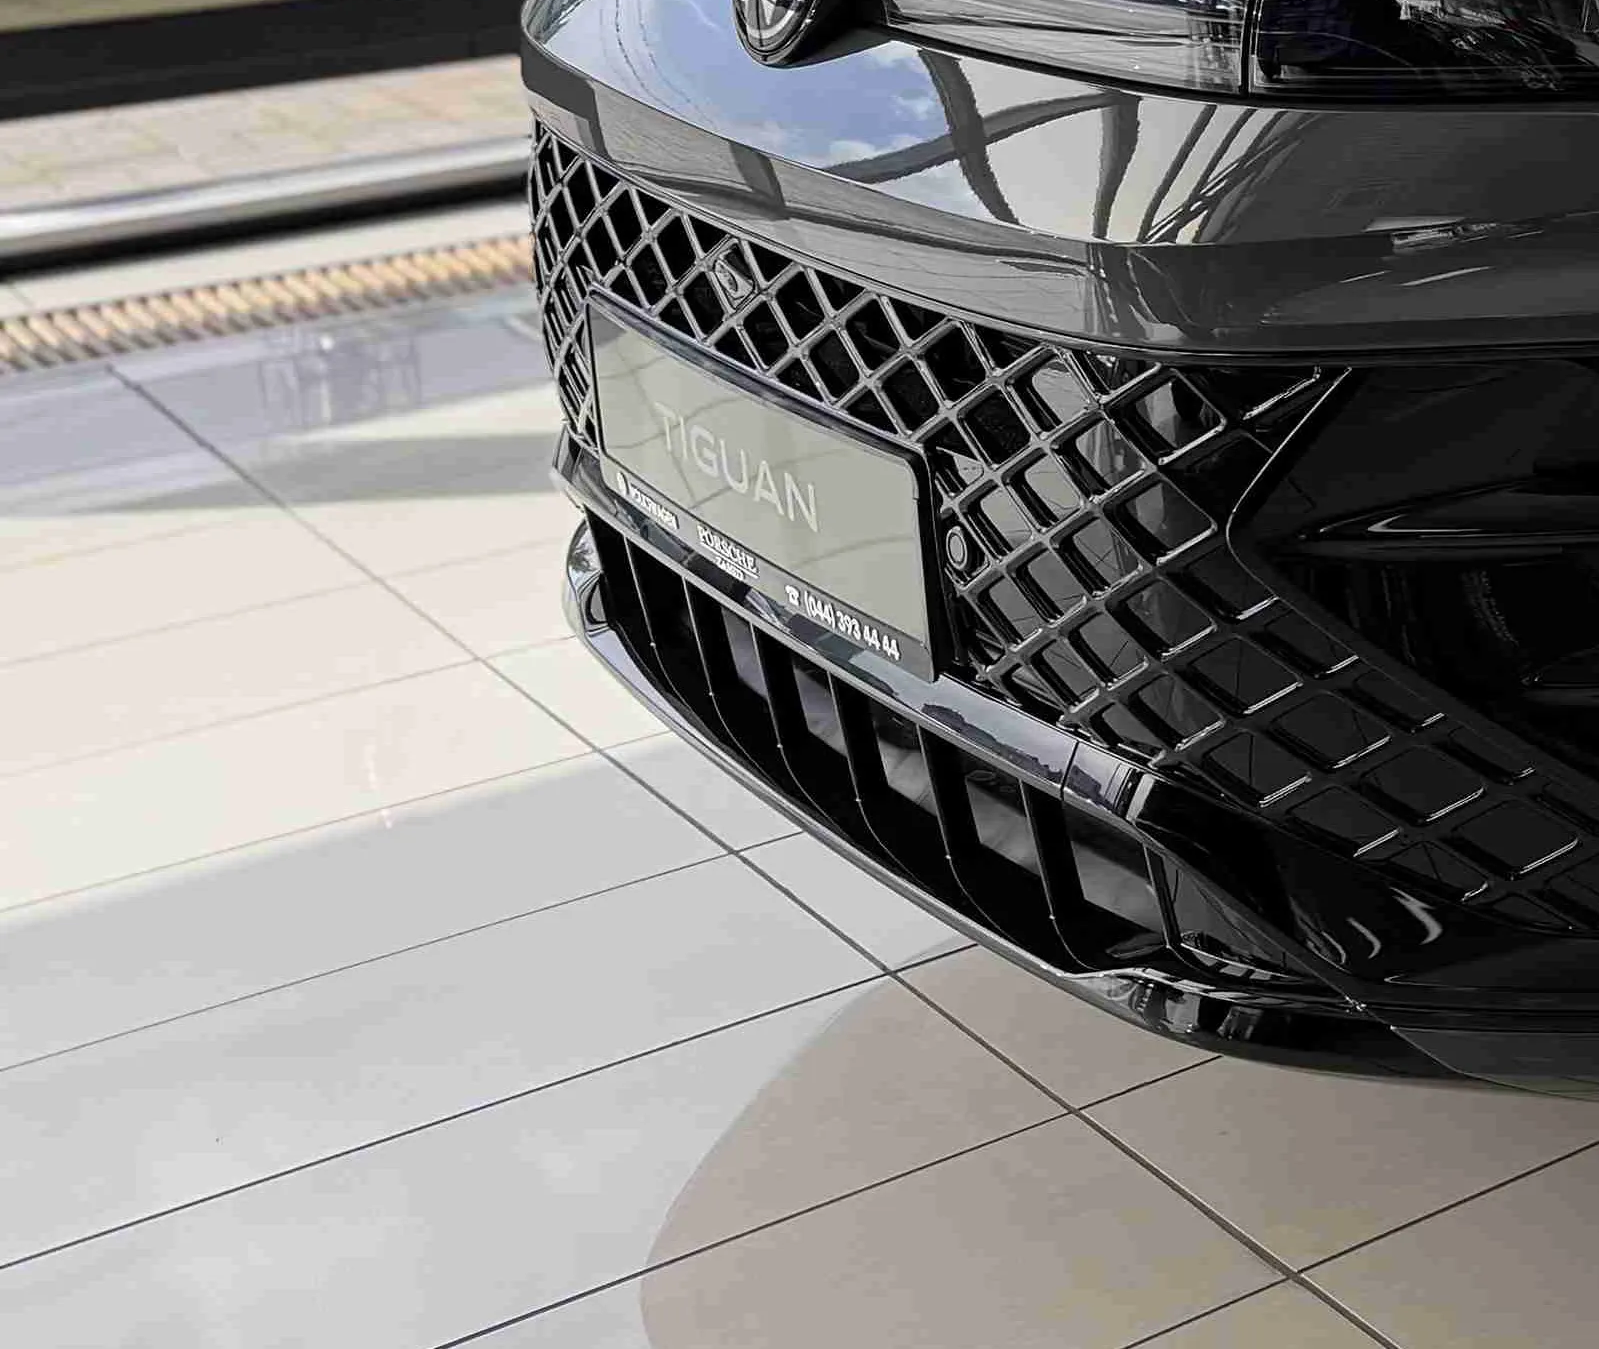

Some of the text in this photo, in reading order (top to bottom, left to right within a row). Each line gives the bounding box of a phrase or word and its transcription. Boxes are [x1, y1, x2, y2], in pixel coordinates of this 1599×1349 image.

[654, 401, 818, 532] TIGUAN
[697, 525, 759, 573] PORSCHE
[804, 591, 900, 661] (044) 393 44 44
